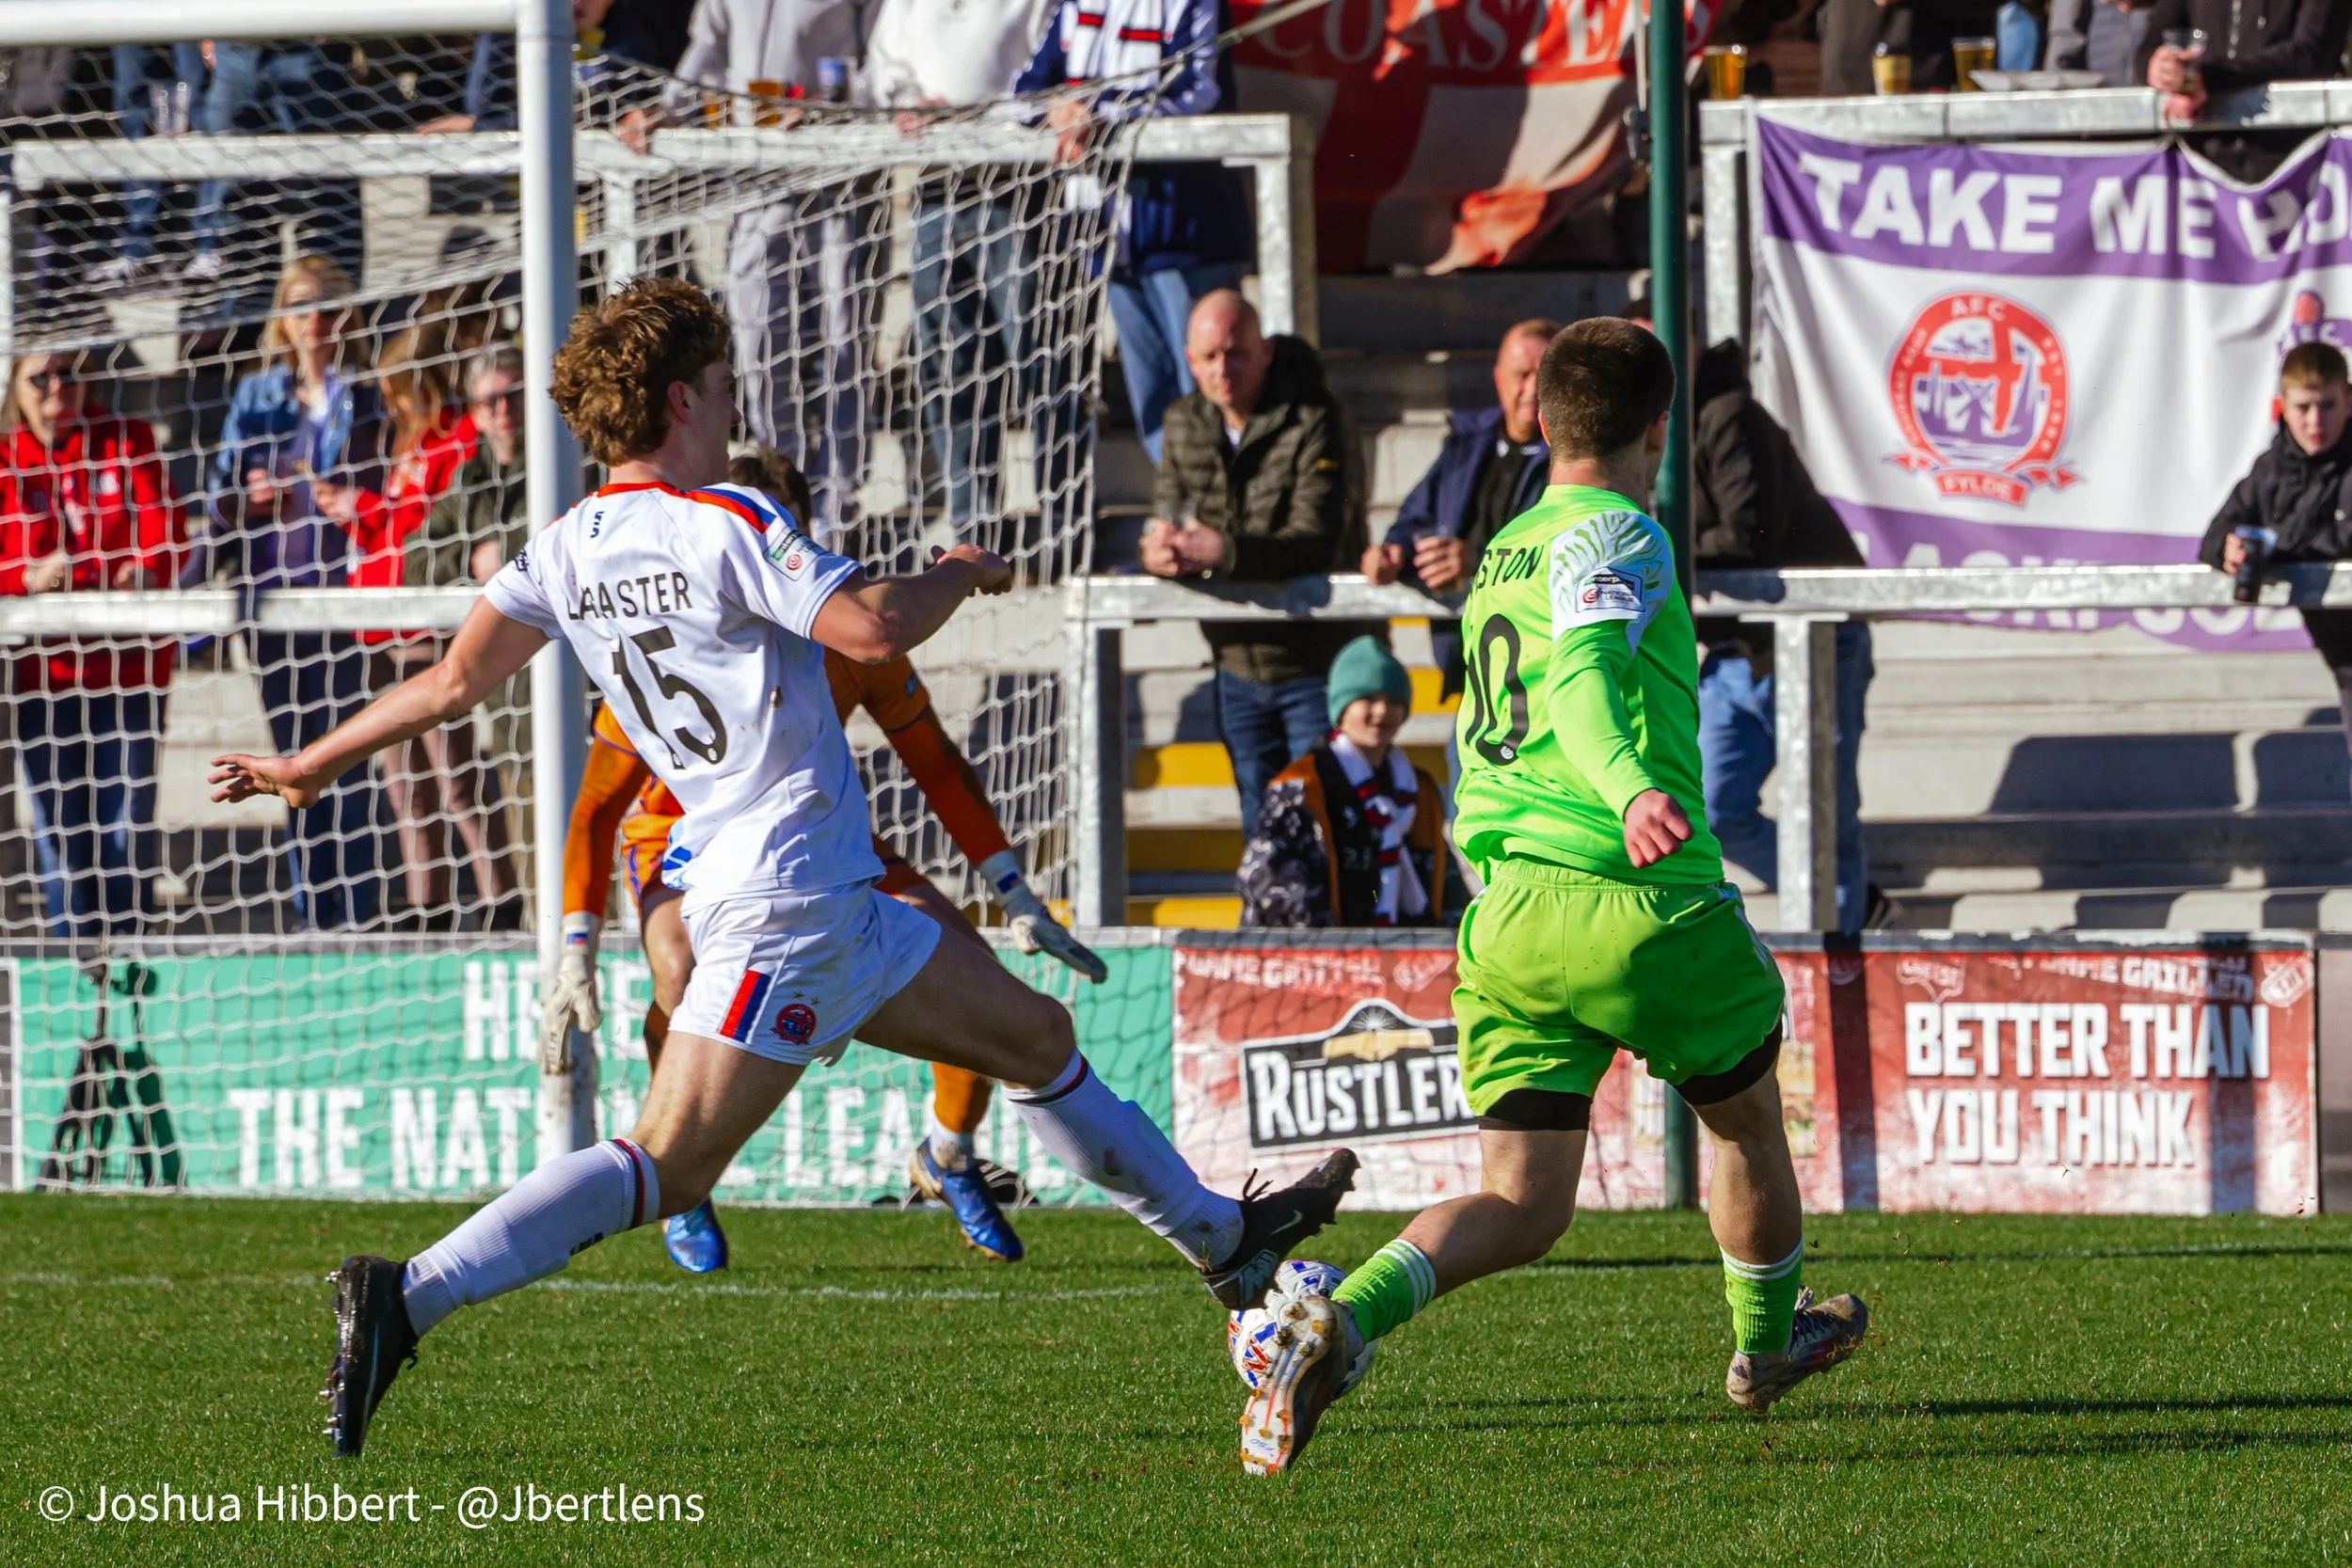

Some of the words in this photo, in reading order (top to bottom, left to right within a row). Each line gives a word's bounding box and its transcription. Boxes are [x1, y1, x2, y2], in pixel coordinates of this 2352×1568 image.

[1796, 152, 2061, 253] TAKE
[2090, 176, 2217, 260] ME
[2236, 160, 2352, 262] HO
[1950, 296, 2006, 322] AFC
[1472, 545, 1545, 592] STON
[612, 626, 728, 770] 15
[464, 958, 652, 1062] HEE
[1905, 1003, 2111, 1077] BETTER
[2120, 1003, 2270, 1079] THAN
[229, 1087, 364, 1187] THE
[786, 1085, 1066, 1189] LEAUE
[1249, 1050, 1475, 1141] RUSTLER
[1906, 1088, 2020, 1164] YOU
[2032, 1088, 2197, 1168] THINK
